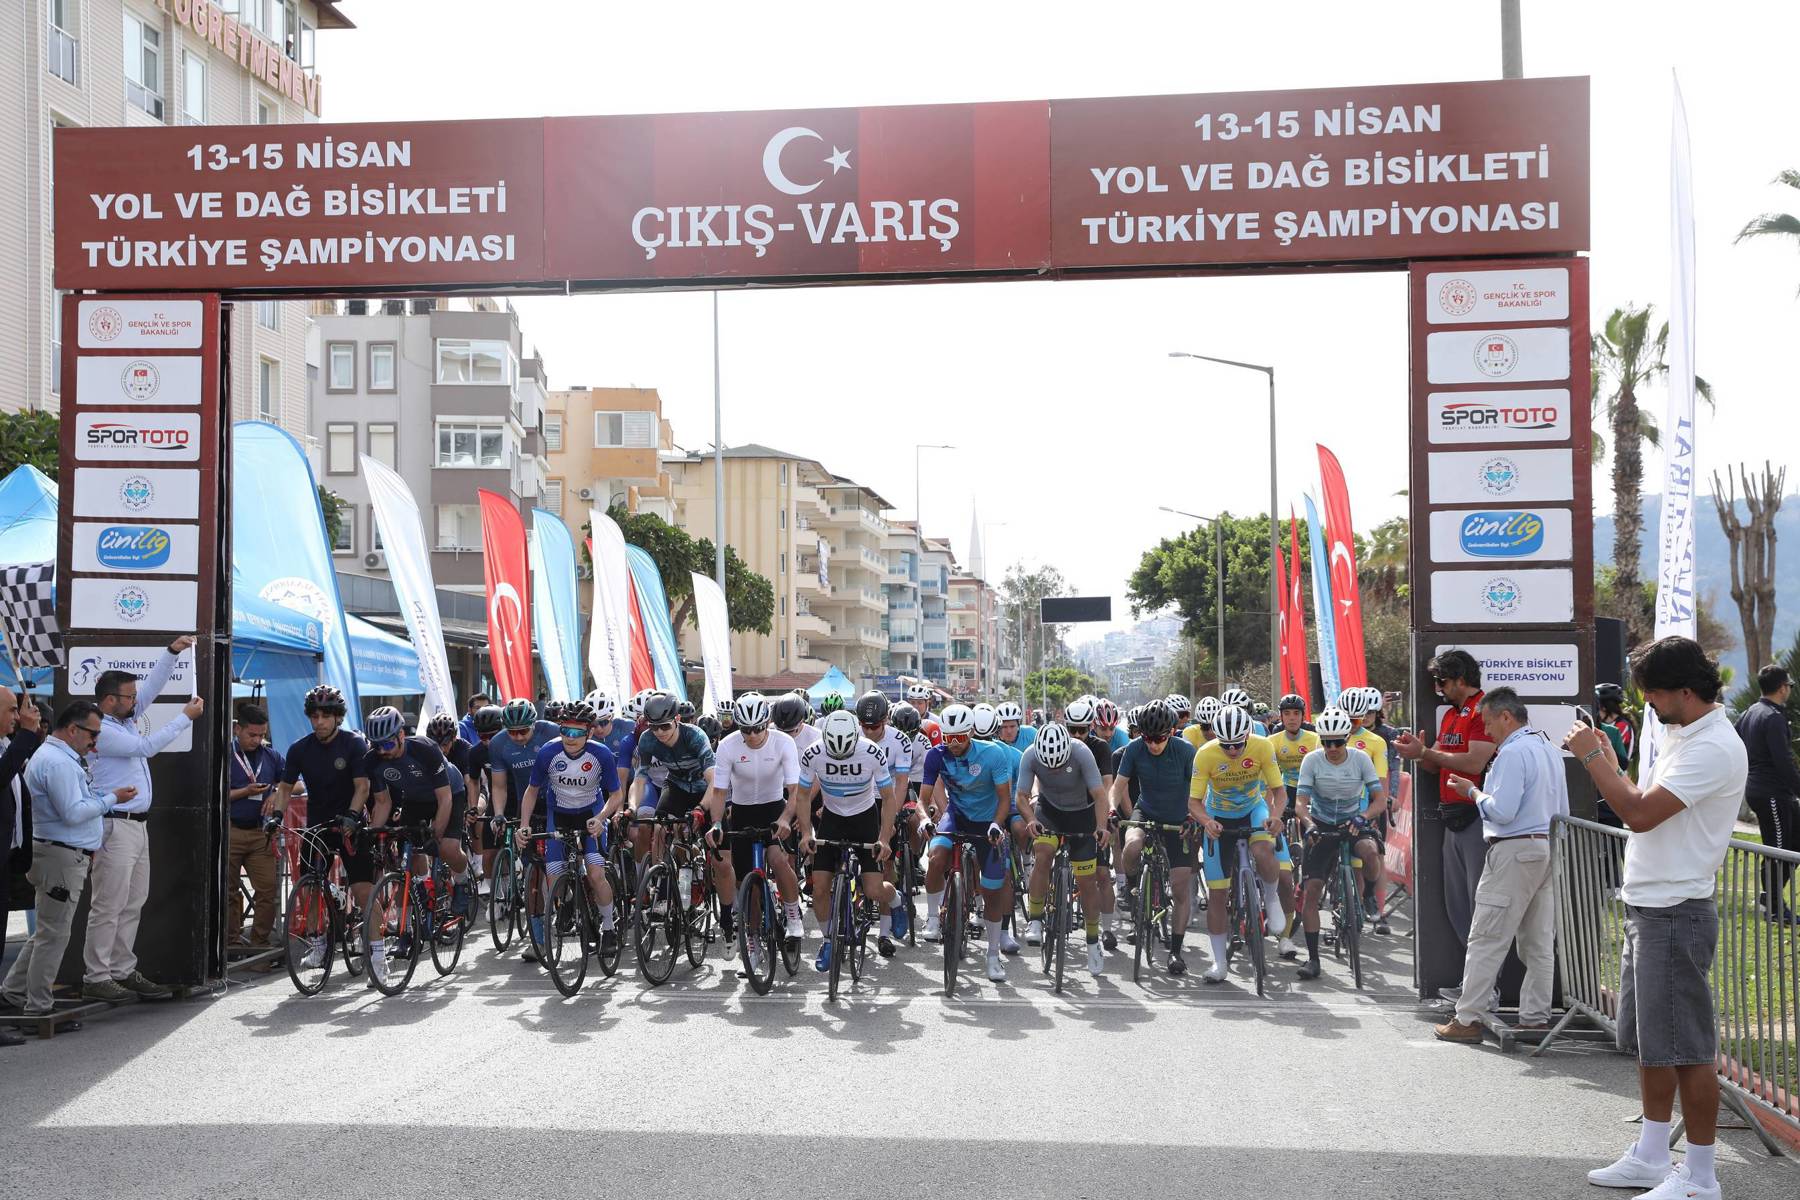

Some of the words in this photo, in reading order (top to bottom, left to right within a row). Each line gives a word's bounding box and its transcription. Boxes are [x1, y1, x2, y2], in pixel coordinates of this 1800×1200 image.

[1194, 110, 1300, 141] 13-15
[1314, 102, 1441, 137] NİSAN
[187, 143, 284, 171] 13-15
[296, 136, 411, 168] NİSAN
[1090, 165, 1169, 195] YOL
[1180, 163, 1234, 192] VE
[1248, 154, 1330, 189] DAĞ
[1344, 144, 1549, 186] BİSİKLETİ
[89, 193, 163, 220] YOL
[174, 192, 223, 219] VE
[236, 185, 311, 217] DAĞ
[324, 180, 507, 216] BİSİKLETİ
[631, 198, 960, 260] ÇIKIŞ-VARIŞ
[1081, 207, 1260, 245] TÜRKİYE
[1273, 201, 1560, 245] ŞAMPİYONASI
[81, 234, 248, 268] TÜRKİYE
[259, 230, 515, 272] ŞAMPİYONASI
[1521, 291, 1532, 299] VE
[1533, 290, 1556, 298] SPOR
[161, 320, 171, 328] VE
[171, 320, 192, 328] SPOR
[107, 659, 147, 669] TÜRKİYE
[1479, 657, 1524, 669] TÜRKİYE
[1526, 657, 1573, 669] BİSİKLET
[1486, 673, 1565, 681] FEDERASYONU
[894, 731, 912, 754] DEU
[801, 744, 822, 768] DEU
[866, 744, 887, 767] DEU
[825, 762, 862, 776] DEU
[558, 775, 588, 787] KMÜ
